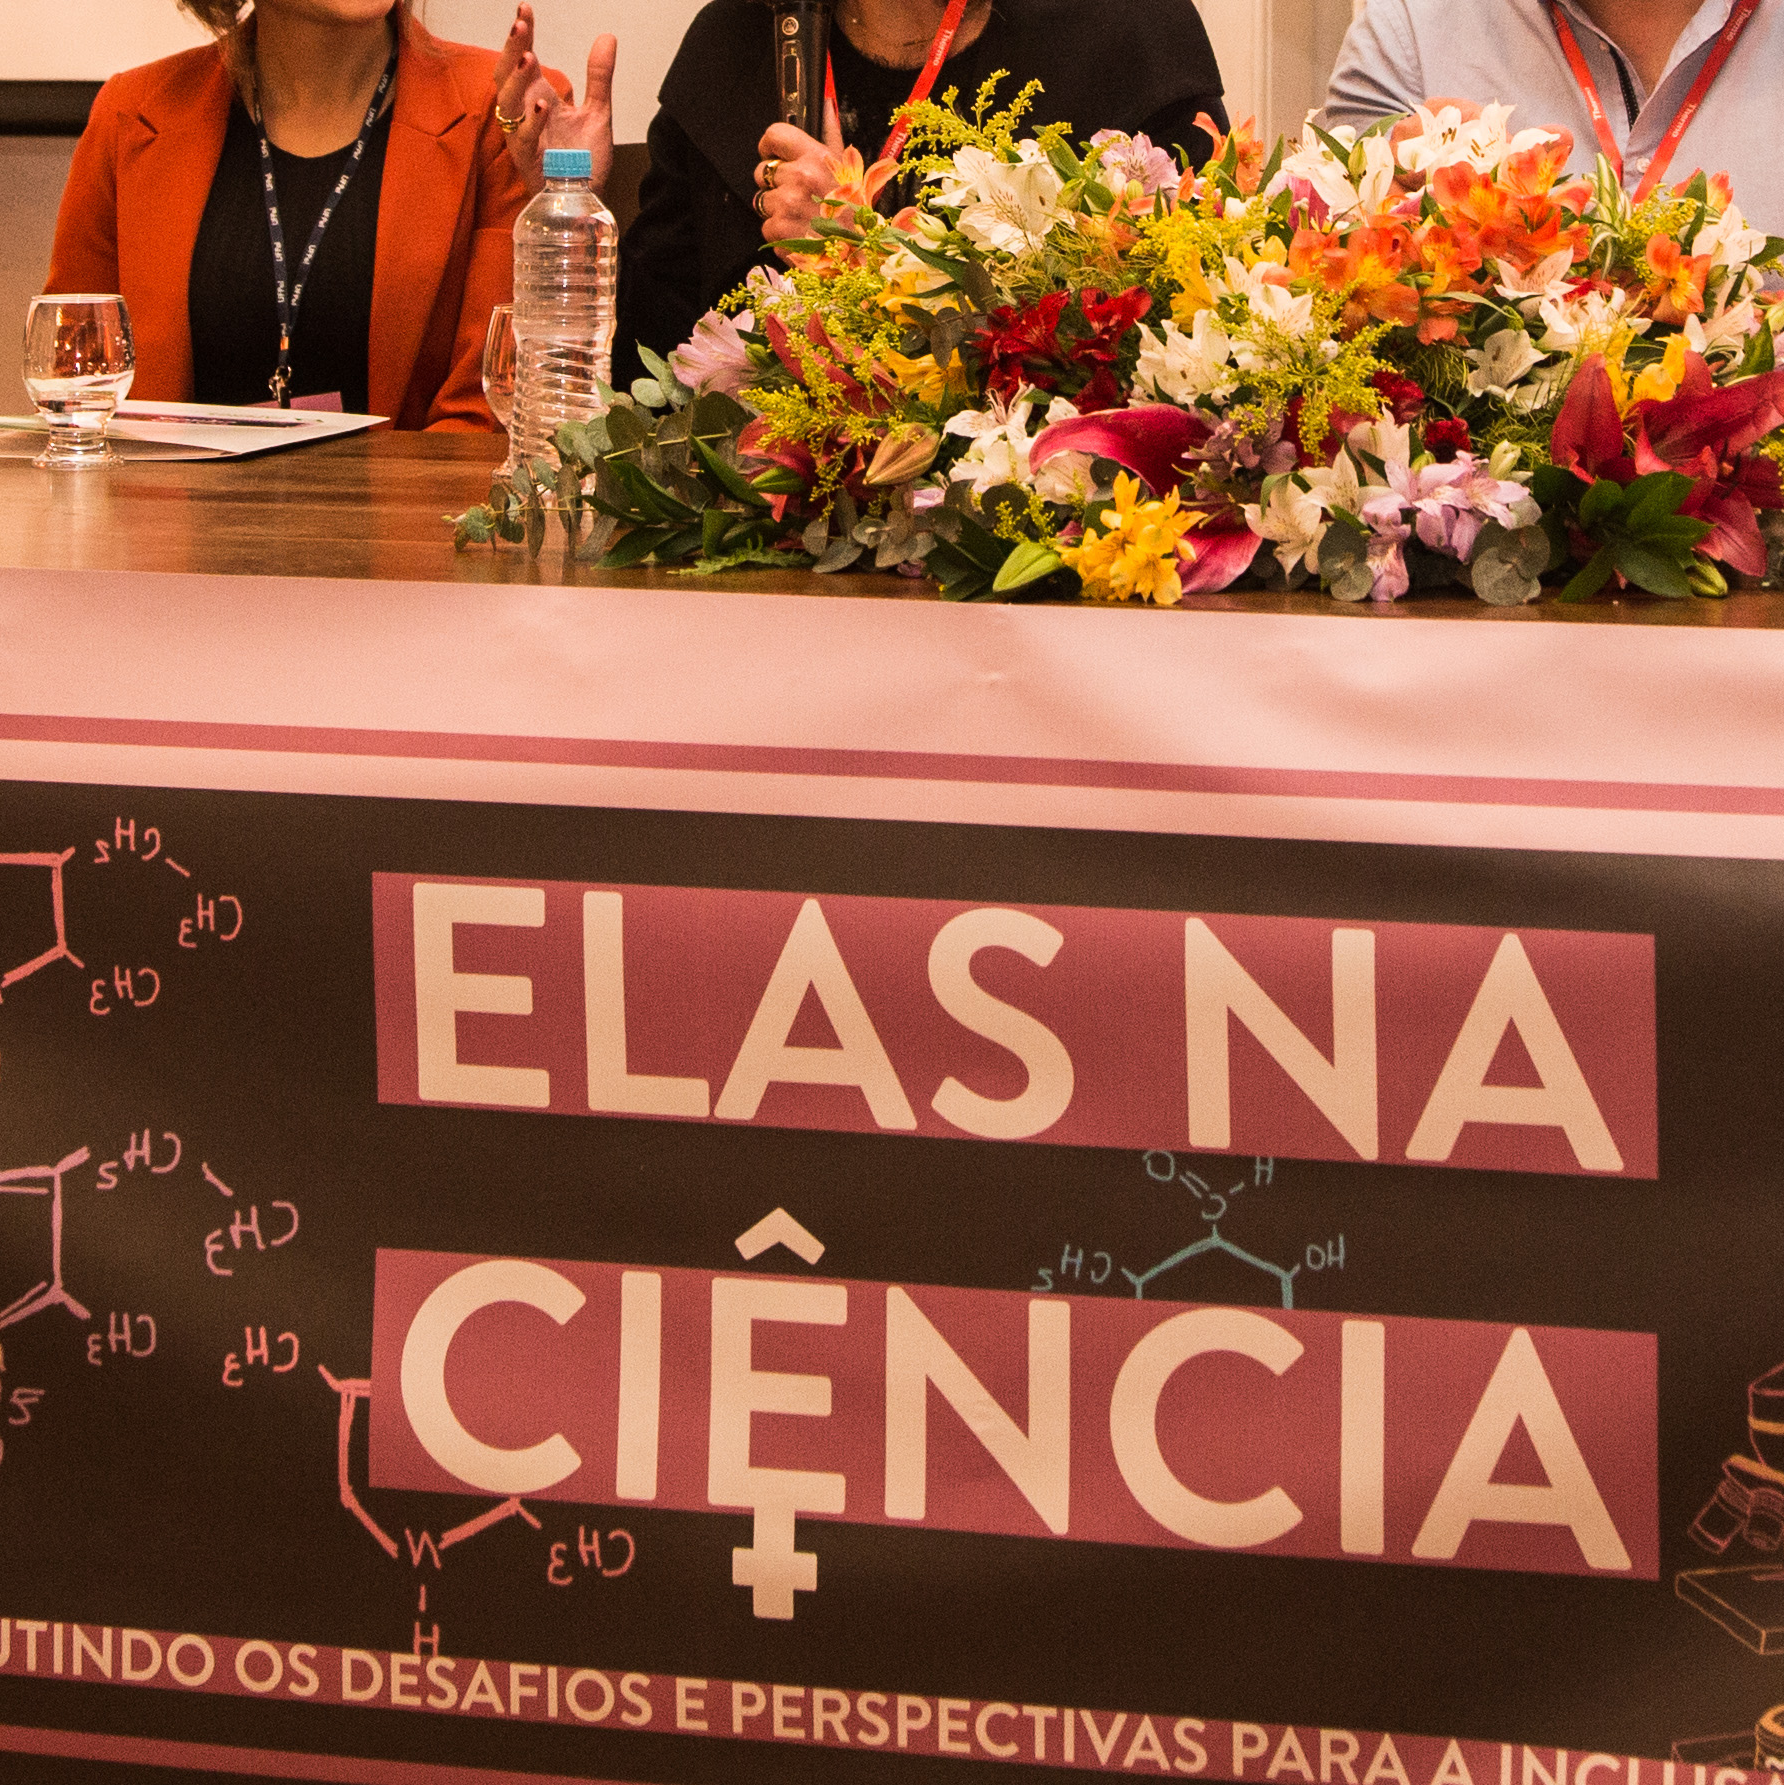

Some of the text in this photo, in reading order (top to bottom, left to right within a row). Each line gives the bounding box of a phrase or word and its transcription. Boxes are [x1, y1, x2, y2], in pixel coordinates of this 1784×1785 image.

[932, 28, 956, 67] Thermo
[1726, 7, 1753, 42] Thermo
[1672, 102, 1697, 139] Thermo
[412, 881, 1626, 1172] ELAS NA
[399, 1206, 1633, 1572] CIÊNCIA
[233, 1638, 320, 1698] OS
[341, 1646, 653, 1727] DESAFIOS
[675, 1675, 710, 1731] E
[731, 1680, 1208, 1773] PERSPECTIVAS
[1231, 1720, 1411, 1785] PARA
[1430, 1737, 1479, 1785] A
